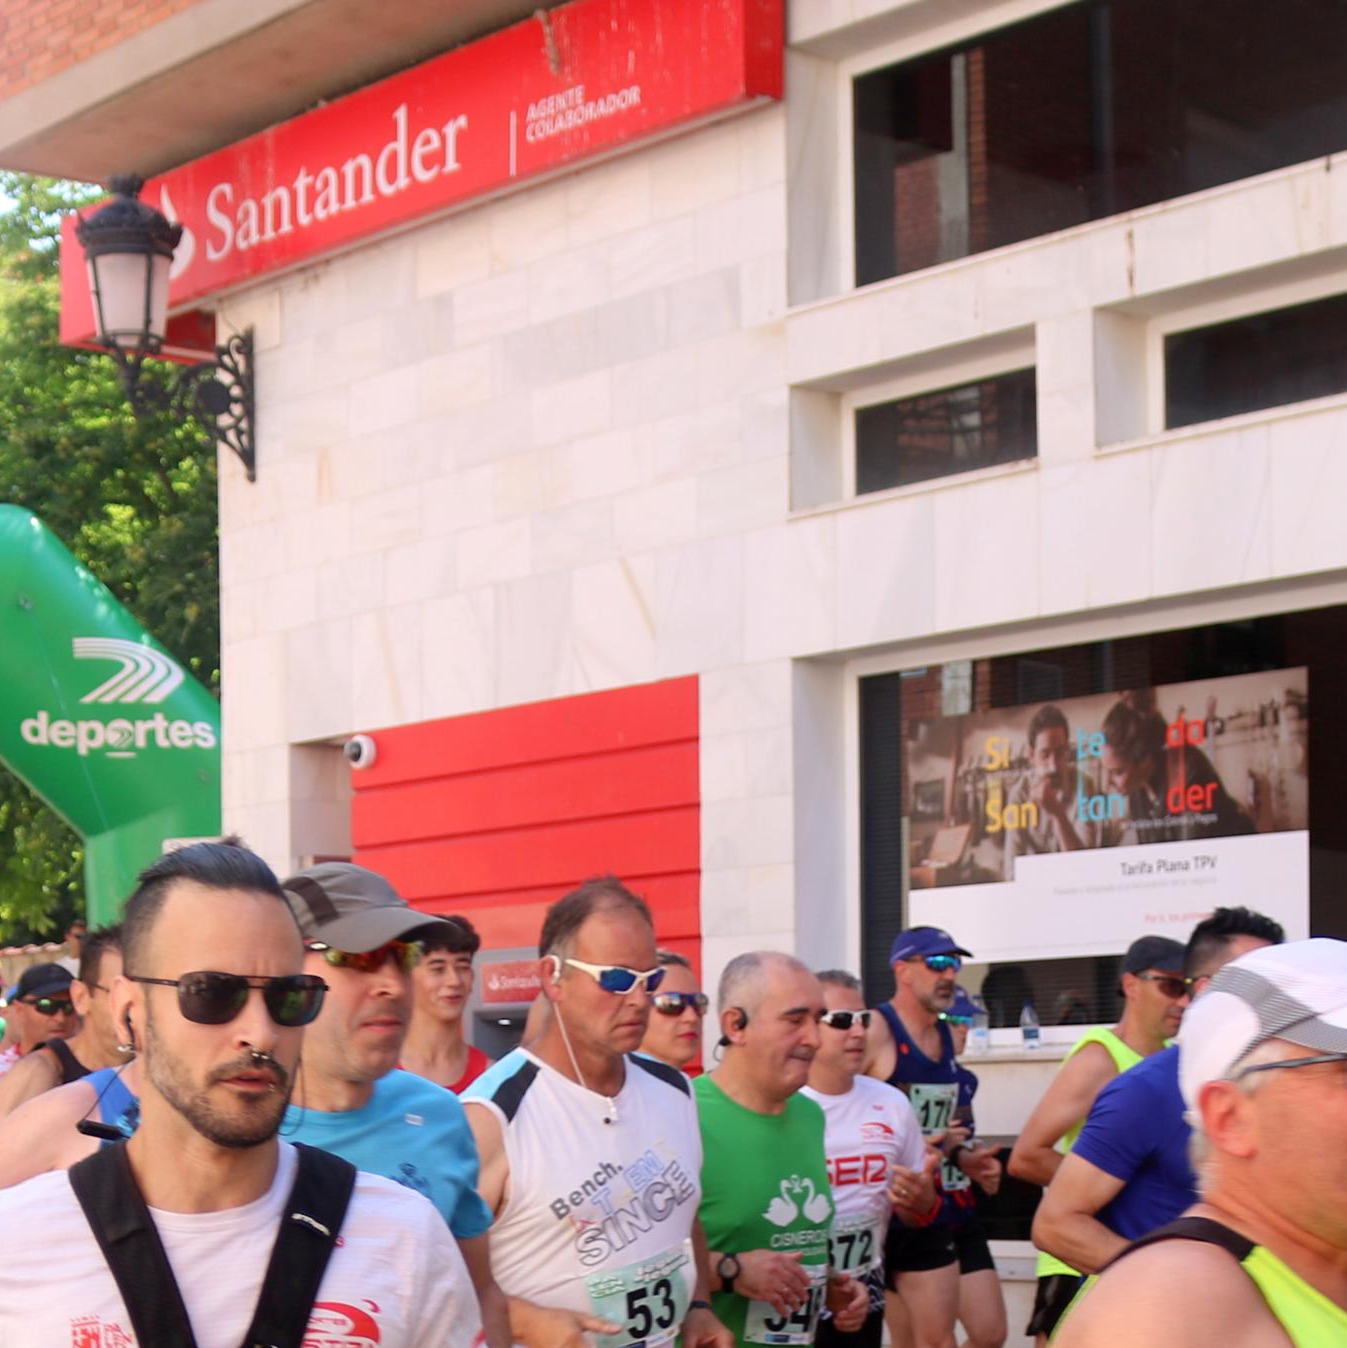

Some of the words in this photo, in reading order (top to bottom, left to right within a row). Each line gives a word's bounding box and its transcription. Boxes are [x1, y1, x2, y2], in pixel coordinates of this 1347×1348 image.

[524, 85, 642, 143] COLABORADOR
[525, 84, 585, 122] AGENTE
[205, 102, 469, 262] Santander
[19, 710, 217, 756] deportes
[985, 737, 1009, 771] Si
[1076, 728, 1107, 760] te
[1166, 711, 1205, 748] da
[985, 800, 1038, 833] San
[1076, 789, 1126, 823] tan
[1166, 781, 1218, 815] der
[1120, 861, 1154, 876] Tarifa
[1156, 858, 1190, 873] Plana
[1192, 855, 1219, 870] TPV
[549, 1161, 623, 1221] Bench.
[574, 1159, 696, 1267] SINCE
[625, 1278, 676, 1339] 53
